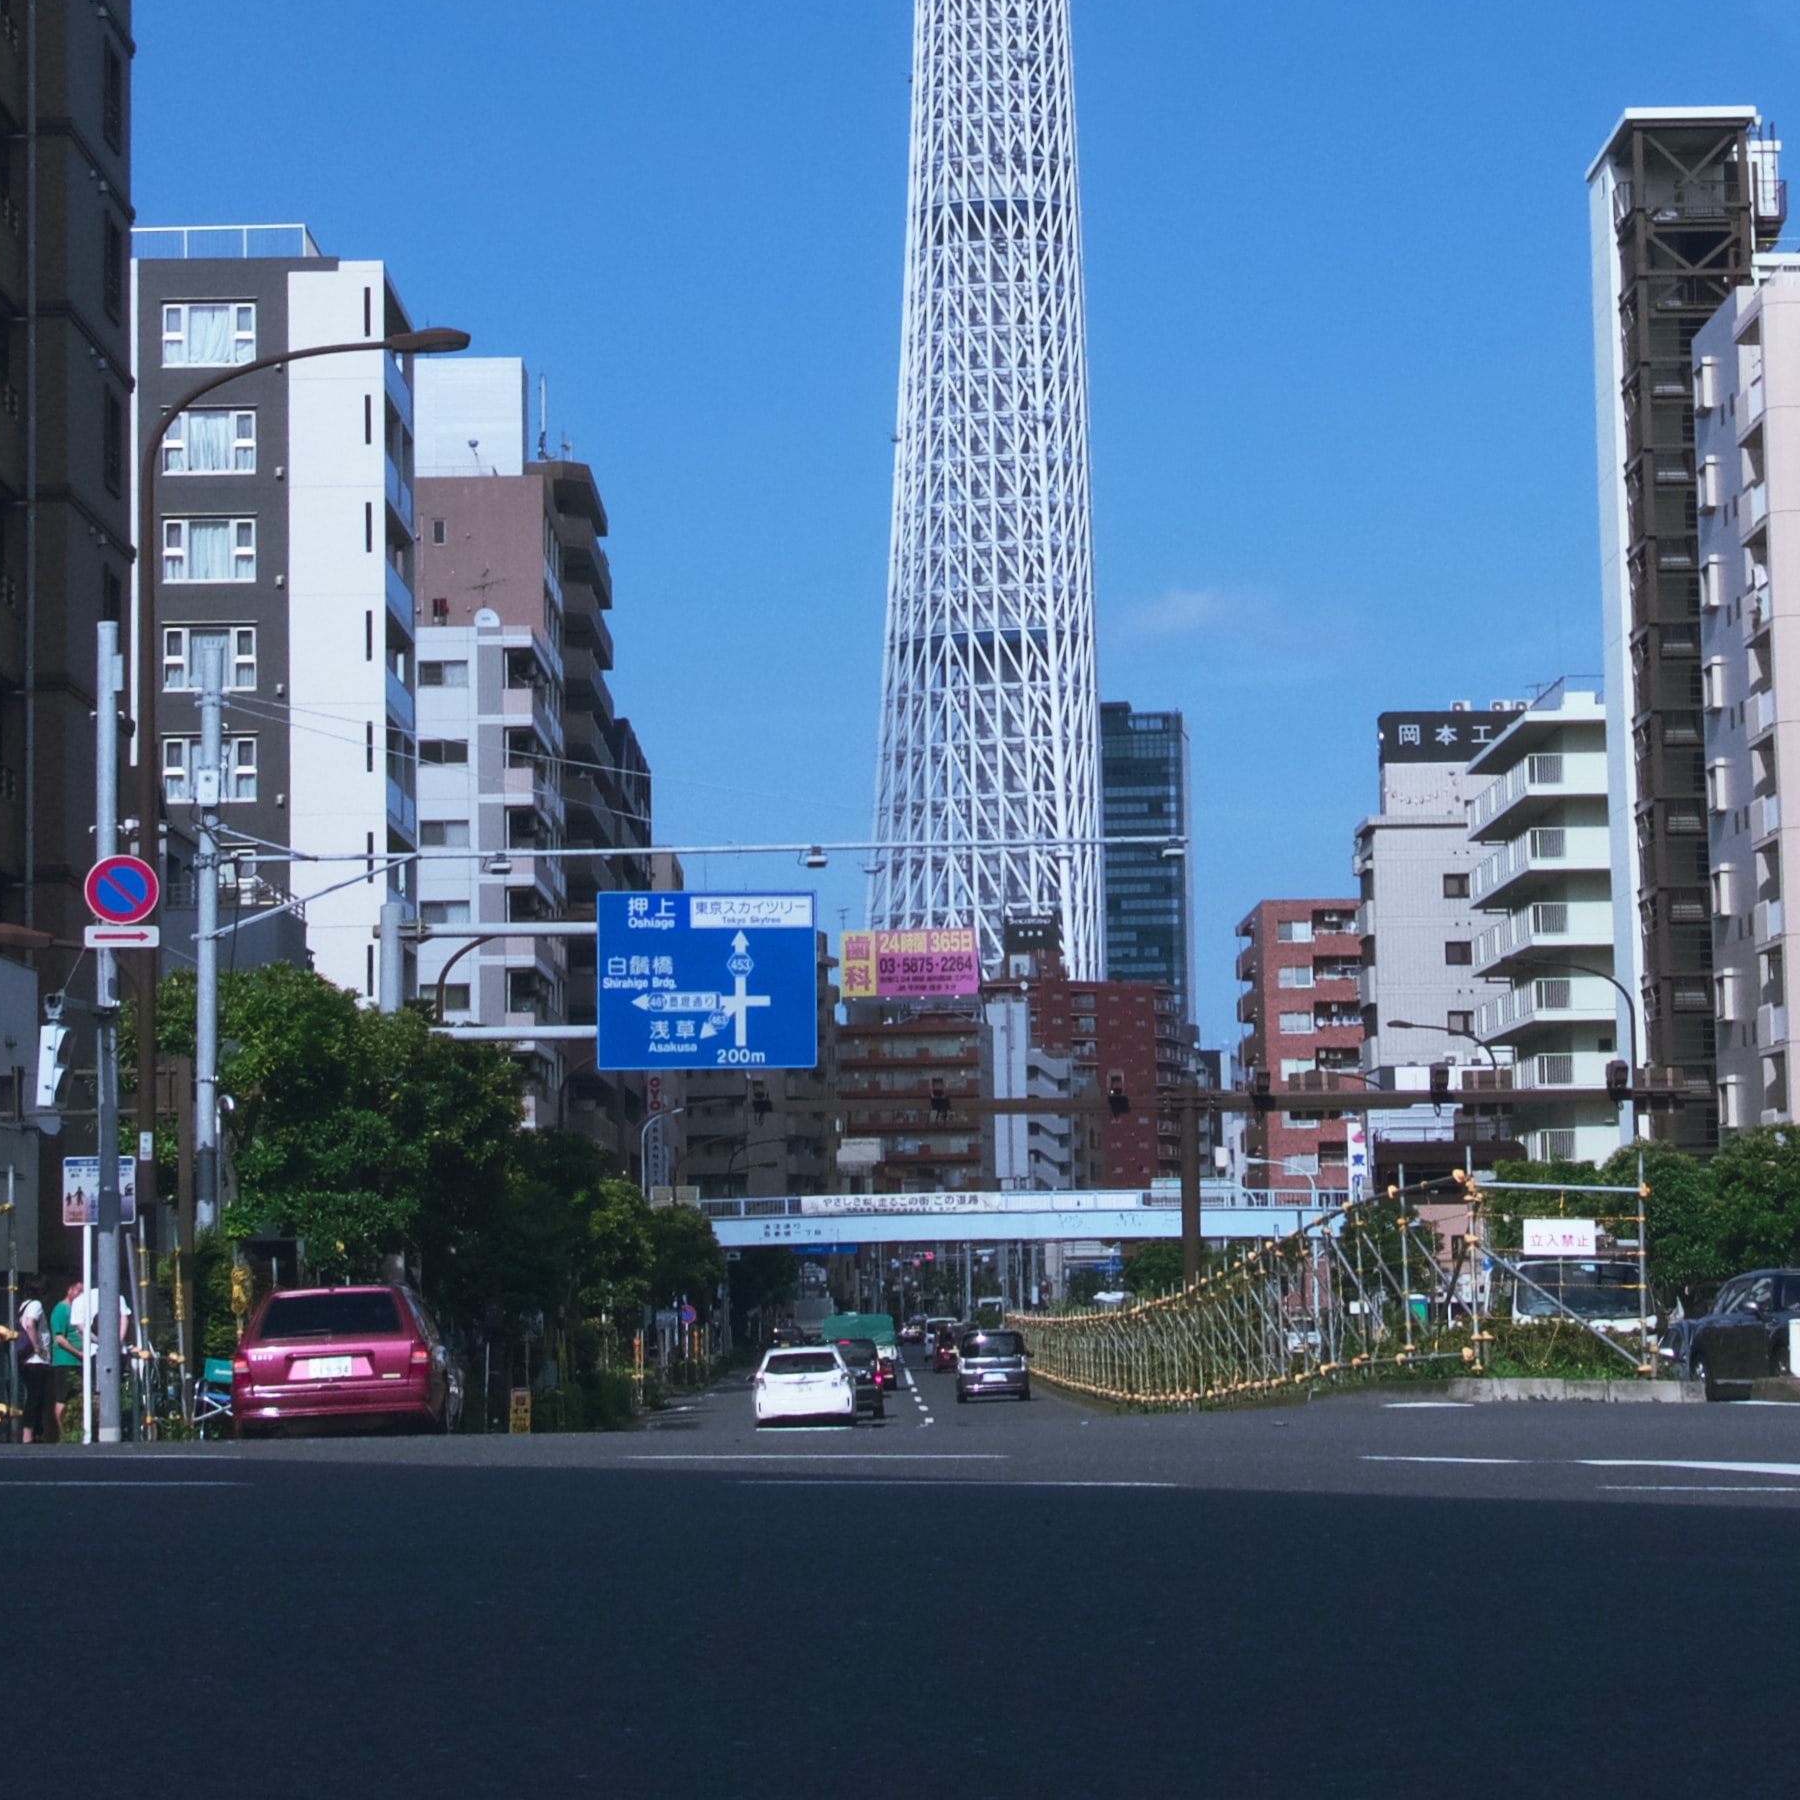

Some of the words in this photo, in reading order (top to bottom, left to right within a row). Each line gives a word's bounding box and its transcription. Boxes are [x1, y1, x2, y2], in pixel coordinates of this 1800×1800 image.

[1399, 724, 1493, 746] 岡本工
[628, 897, 676, 918] 押上
[695, 901, 808, 916] 東京スカイツリー
[628, 917, 676, 930] Oshiage
[722, 915, 747, 926] Tokyo
[750, 915, 782, 926] Skytree
[880, 932, 928, 954] 24時間
[931, 930, 973, 953] 365日
[730, 958, 751, 970] 453
[844, 936, 872, 991] 歯科
[603, 977, 648, 990] Shirahige
[652, 977, 678, 989] Brdg.
[650, 1020, 695, 1040] 浅草
[649, 1042, 697, 1053] Asakusa
[717, 1049, 766, 1064] 200m
[1530, 1233, 1590, 1248] 立入禁止
